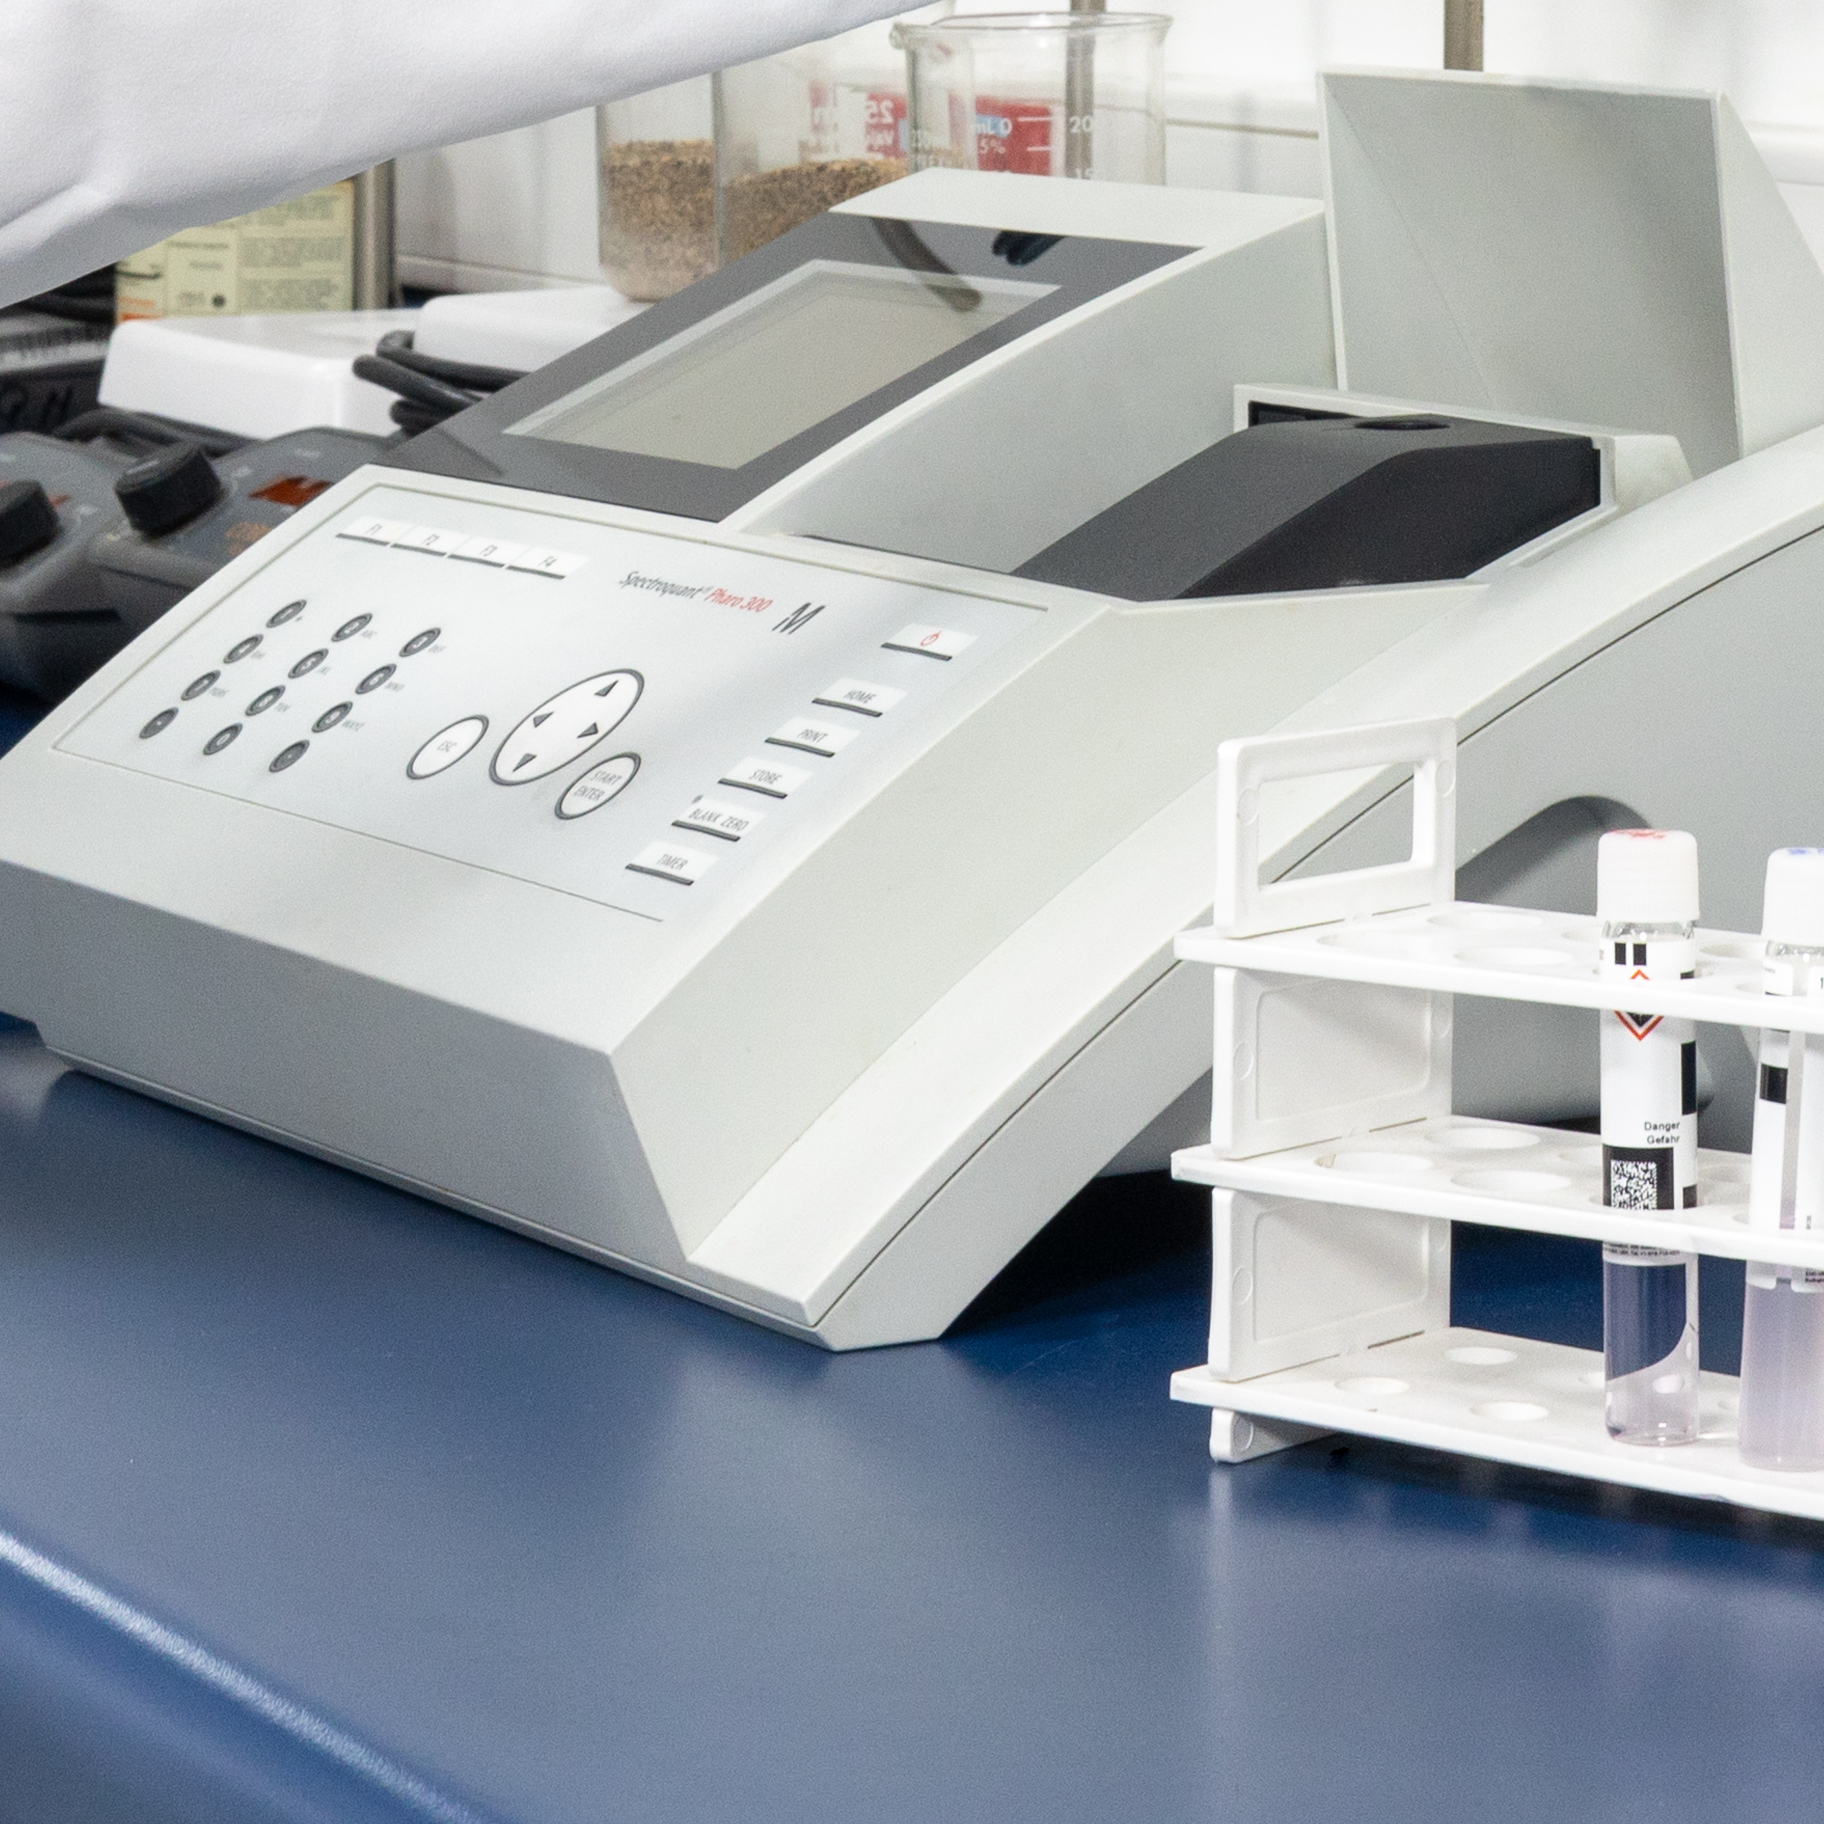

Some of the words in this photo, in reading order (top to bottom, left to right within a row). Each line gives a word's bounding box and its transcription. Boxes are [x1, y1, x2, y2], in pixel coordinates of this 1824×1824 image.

[421, 534, 440, 546] F2
[479, 544, 498, 557] F3
[538, 555, 557, 568] F4
[704, 587, 743, 608] Pharo
[739, 595, 774, 613] 300
[843, 689, 877, 704] HOME
[796, 728, 829, 743] PRINT
[593, 770, 623, 786] START
[748, 769, 782, 785] STORE
[573, 785, 605, 802] ENTER
[688, 807, 725, 824] BLANK
[720, 815, 750, 832] ZERO
[657, 853, 688, 870] TIMER
[1644, 1121, 1681, 1133] Danger
[1646, 1134, 1681, 1145] Gefahr
